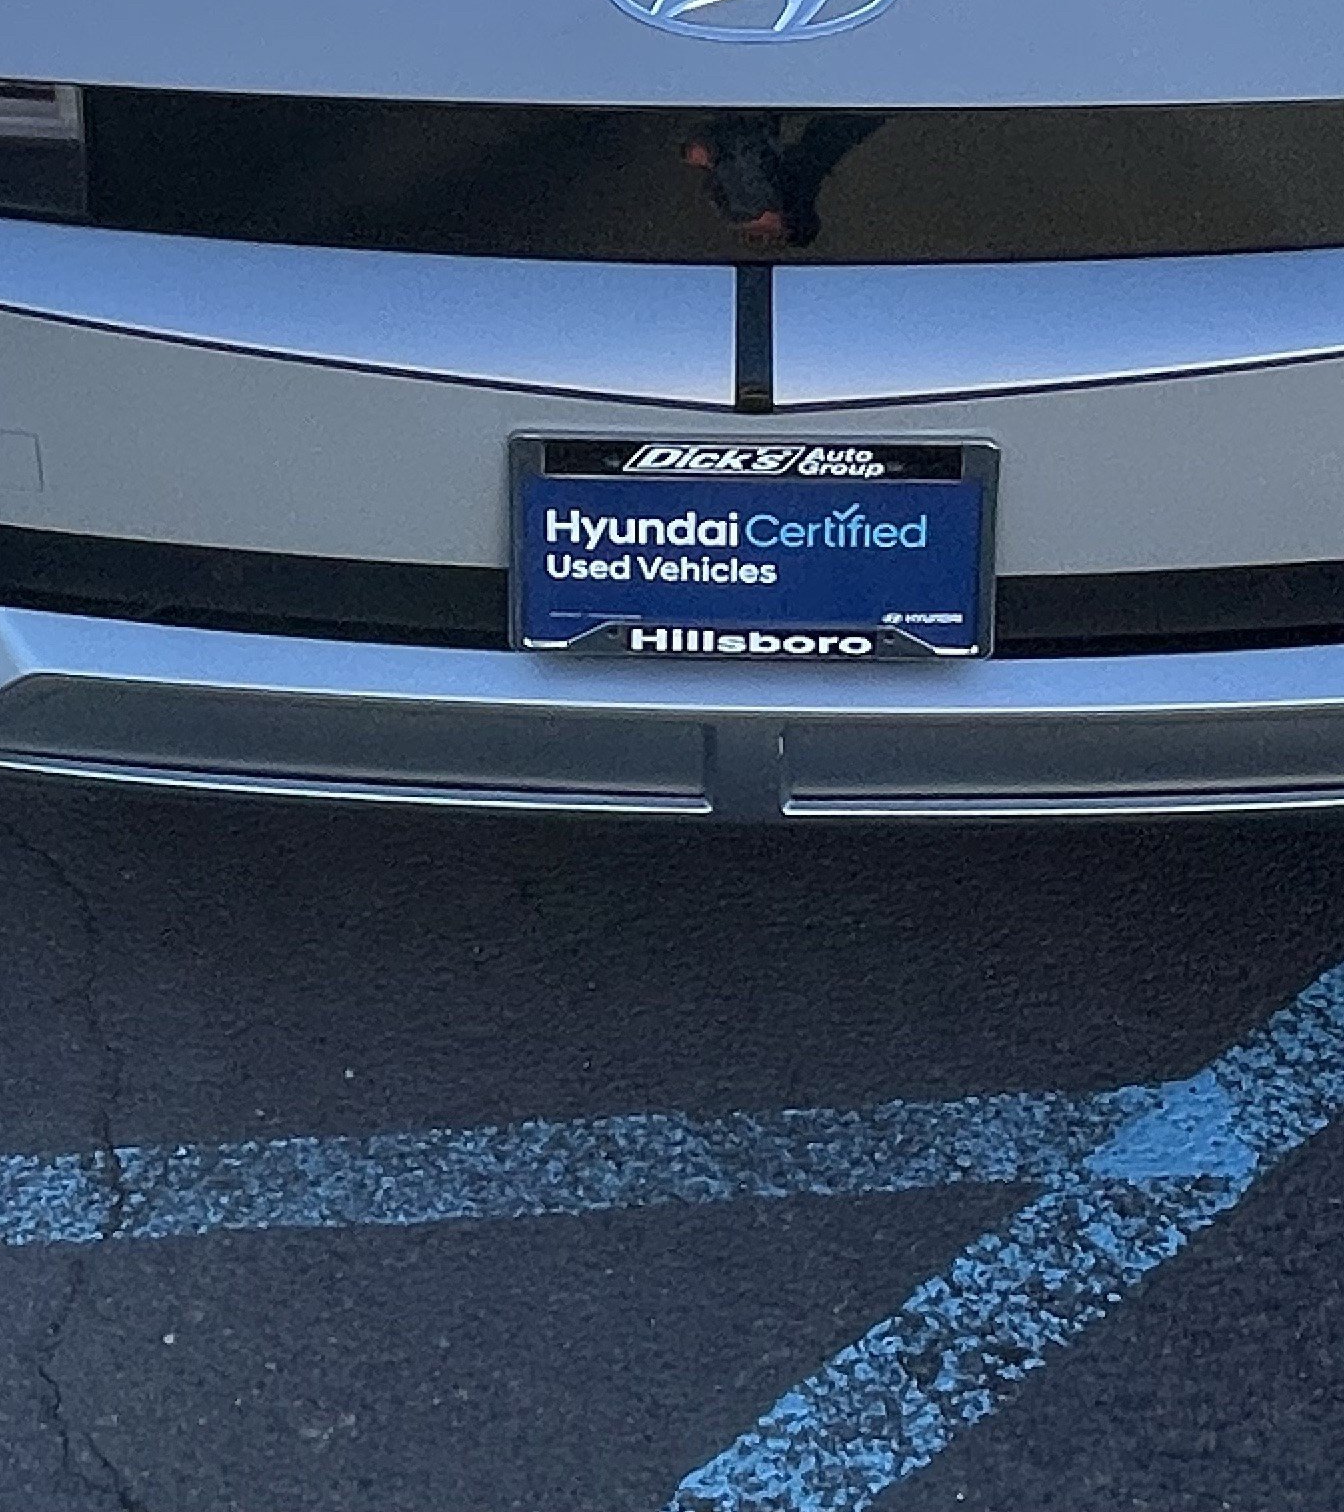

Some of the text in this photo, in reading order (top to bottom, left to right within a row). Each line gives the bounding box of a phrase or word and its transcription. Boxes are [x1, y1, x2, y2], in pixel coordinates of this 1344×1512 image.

[803, 446, 874, 463] Auto
[797, 461, 885, 479] Group
[545, 503, 928, 550] Hyundai Certified
[546, 553, 778, 584] Used Vehicles
[630, 627, 873, 656] Hillsboro
